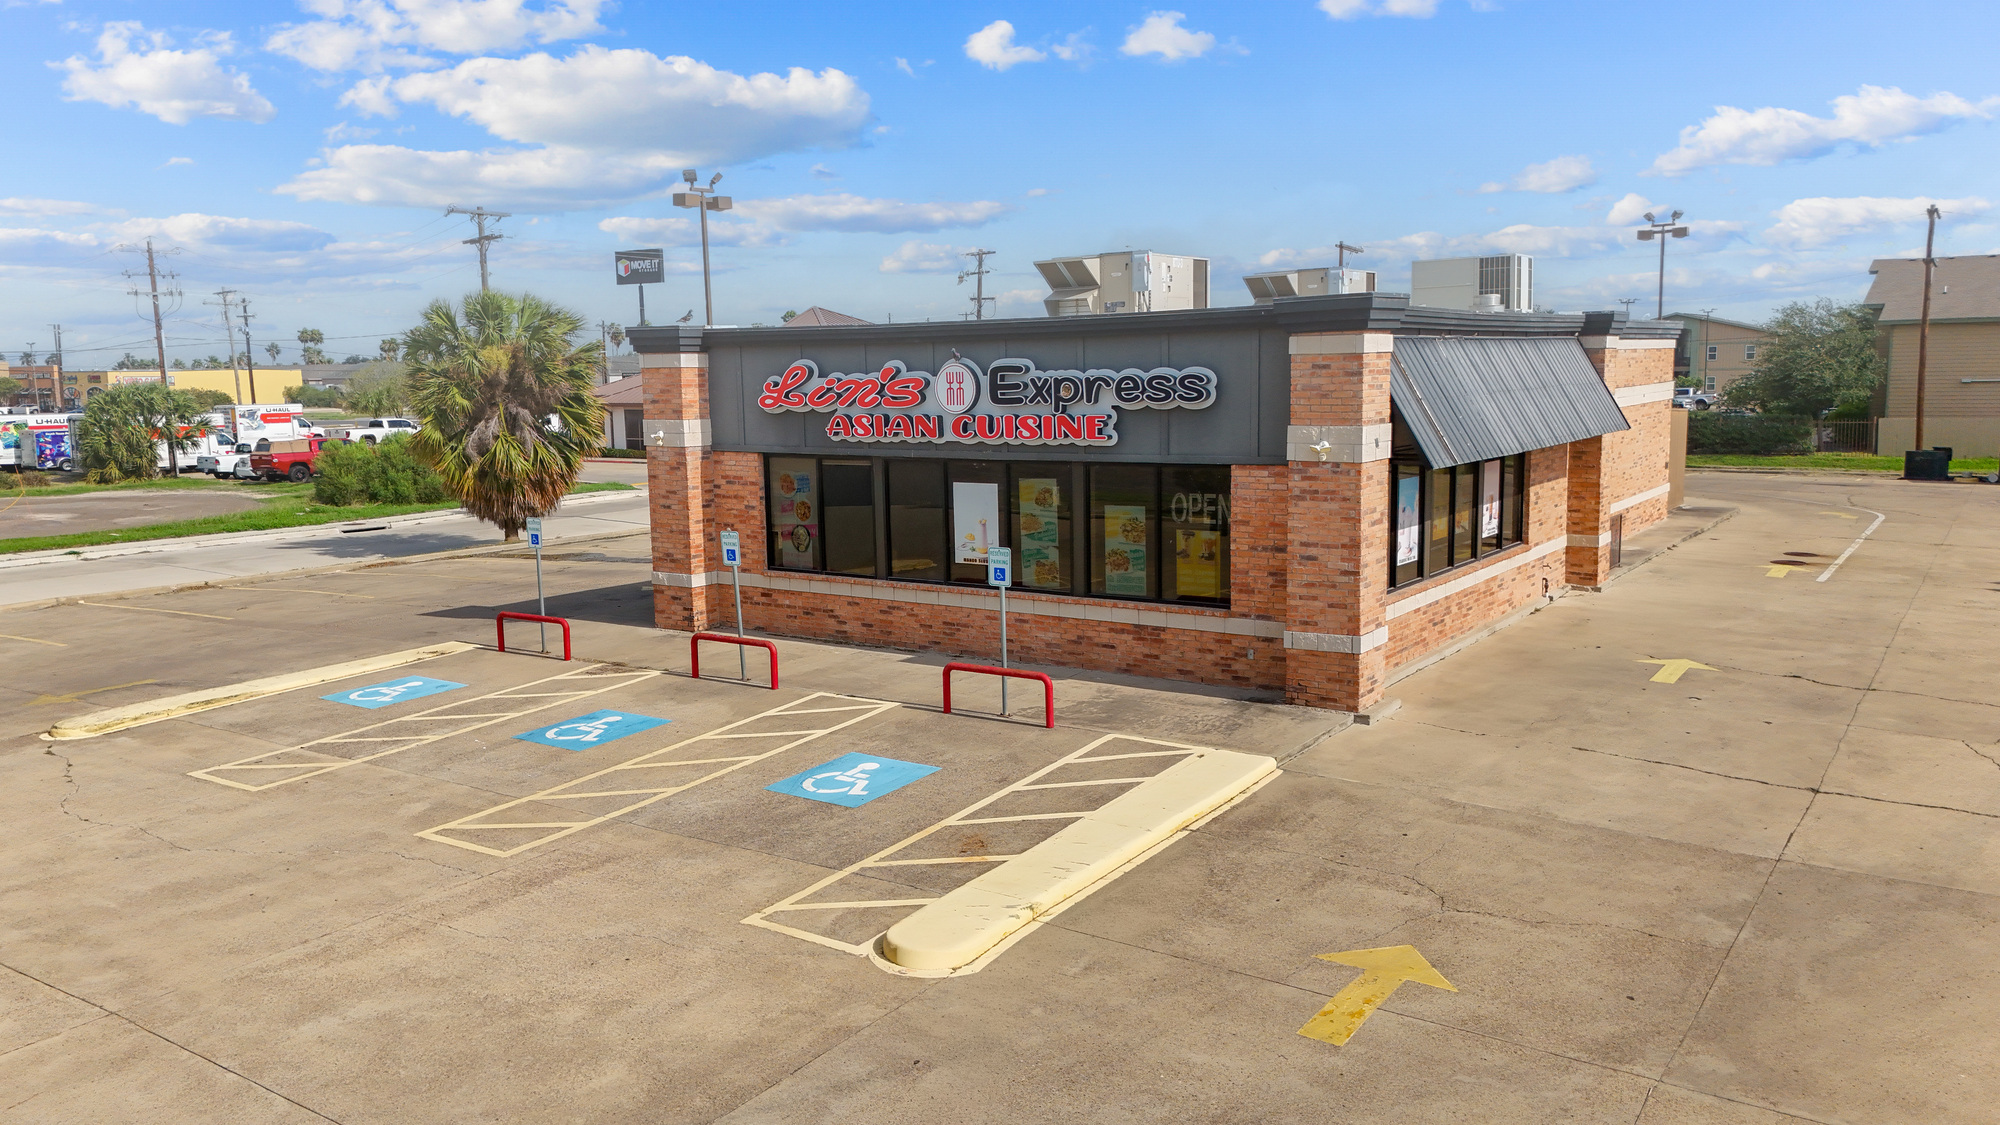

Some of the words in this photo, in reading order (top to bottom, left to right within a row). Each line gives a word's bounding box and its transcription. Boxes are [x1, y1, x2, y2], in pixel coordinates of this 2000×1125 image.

[631, 260, 651, 270] MOVE
[652, 259, 660, 268] IT
[758, 364, 926, 409] Lin's
[986, 364, 1206, 414] Express
[826, 413, 938, 439] ASIAN
[950, 414, 1109, 440] CUISINE
[1171, 492, 1231, 525] OPEN
